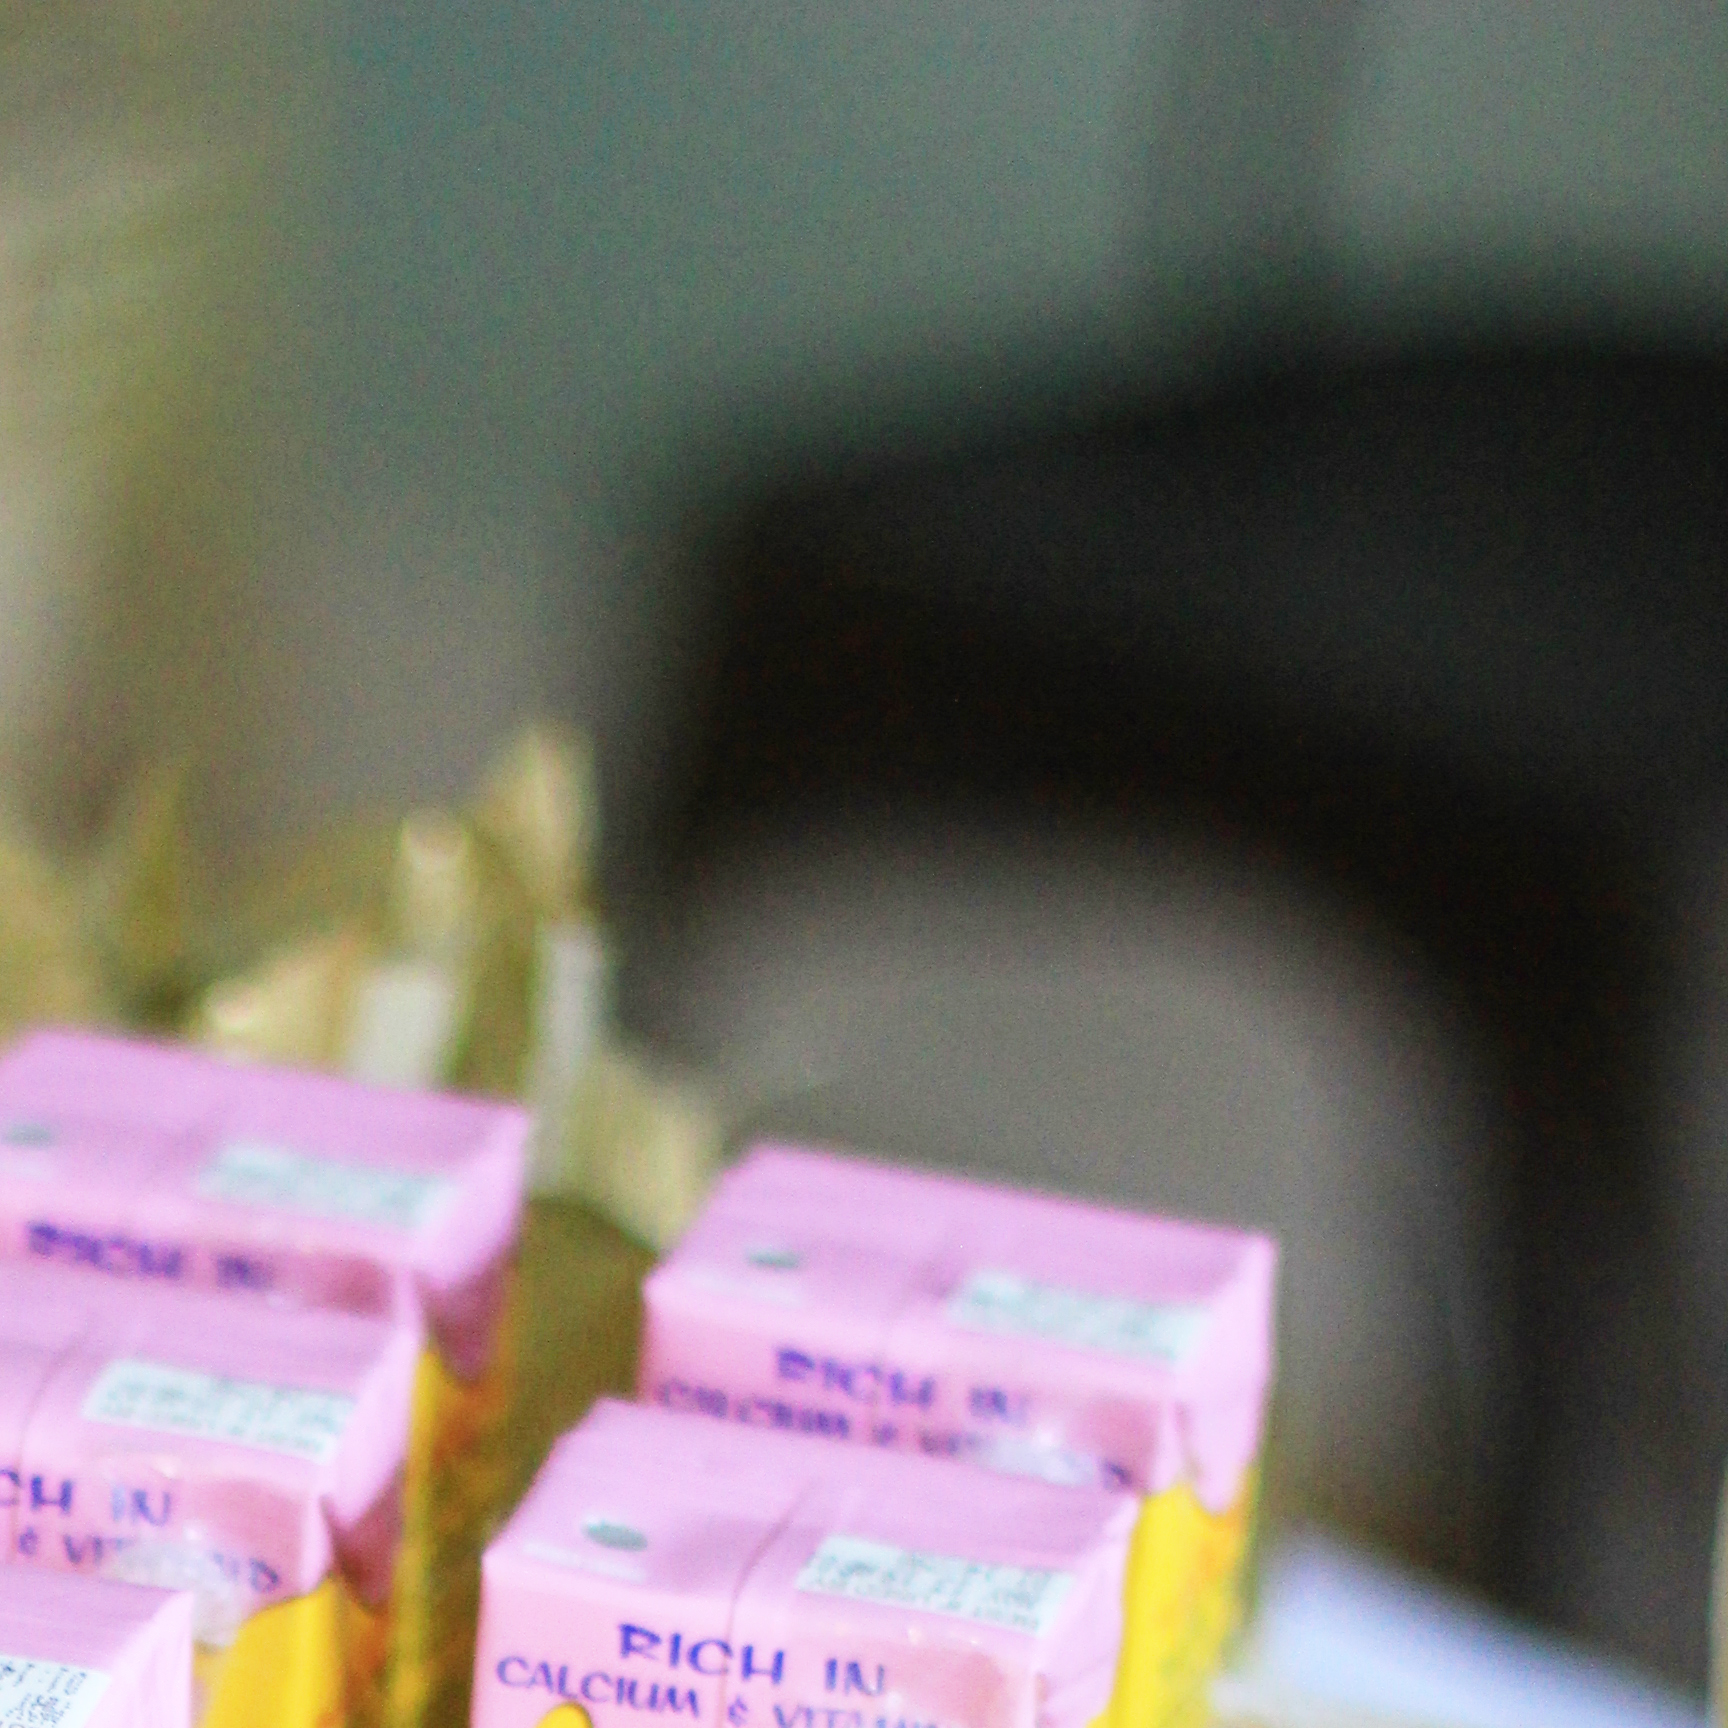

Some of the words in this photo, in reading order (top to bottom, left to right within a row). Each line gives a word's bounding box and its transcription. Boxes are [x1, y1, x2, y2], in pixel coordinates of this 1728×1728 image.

[110, 1485, 169, 1526] IN
[495, 1655, 700, 1718] CALCIUM
[618, 1622, 785, 1686] RICH
[825, 1658, 885, 1697] IN
